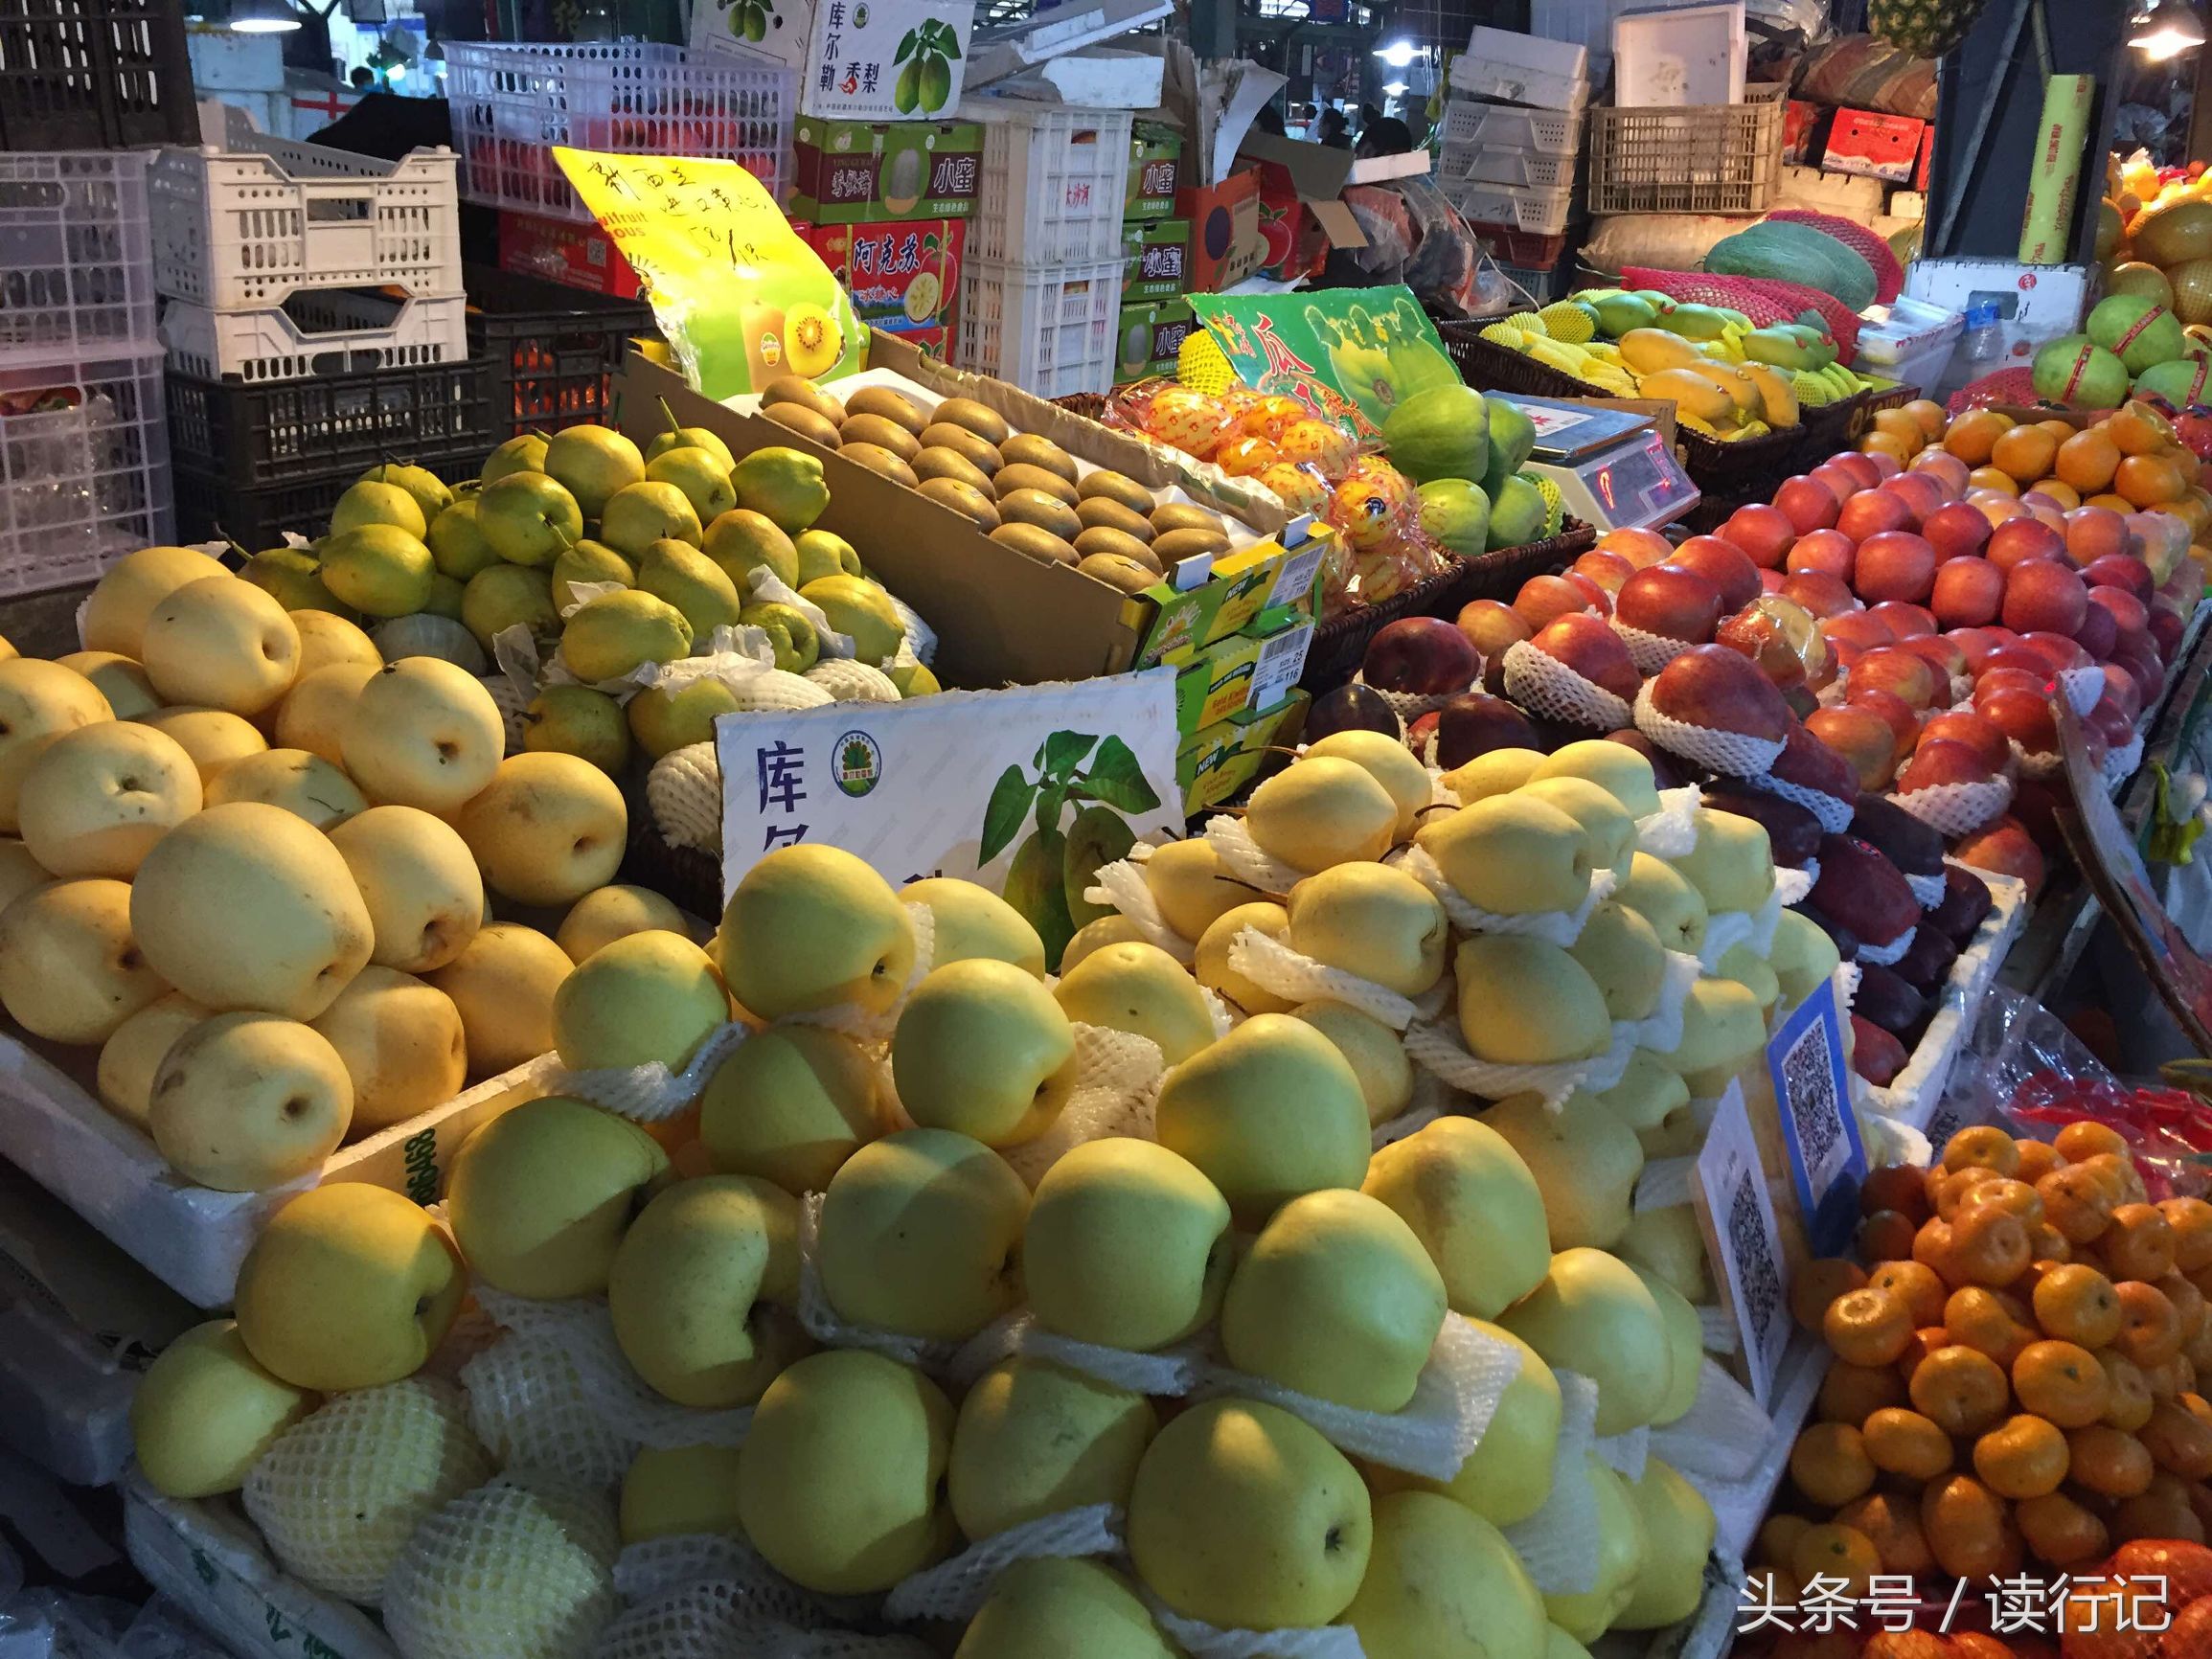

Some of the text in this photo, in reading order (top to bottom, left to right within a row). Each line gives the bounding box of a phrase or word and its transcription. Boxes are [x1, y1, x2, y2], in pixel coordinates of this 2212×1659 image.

[819, 2, 847, 92] 库尔勒
[933, 157, 976, 193] 小蜜
[1143, 164, 1175, 193] 小蜜
[854, 232, 921, 275] 阿克苏
[1144, 247, 1183, 278] 小蜜
[1225, 578, 1249, 602] NEW
[1292, 649, 1304, 663] 25
[1197, 750, 1220, 776] NEW
